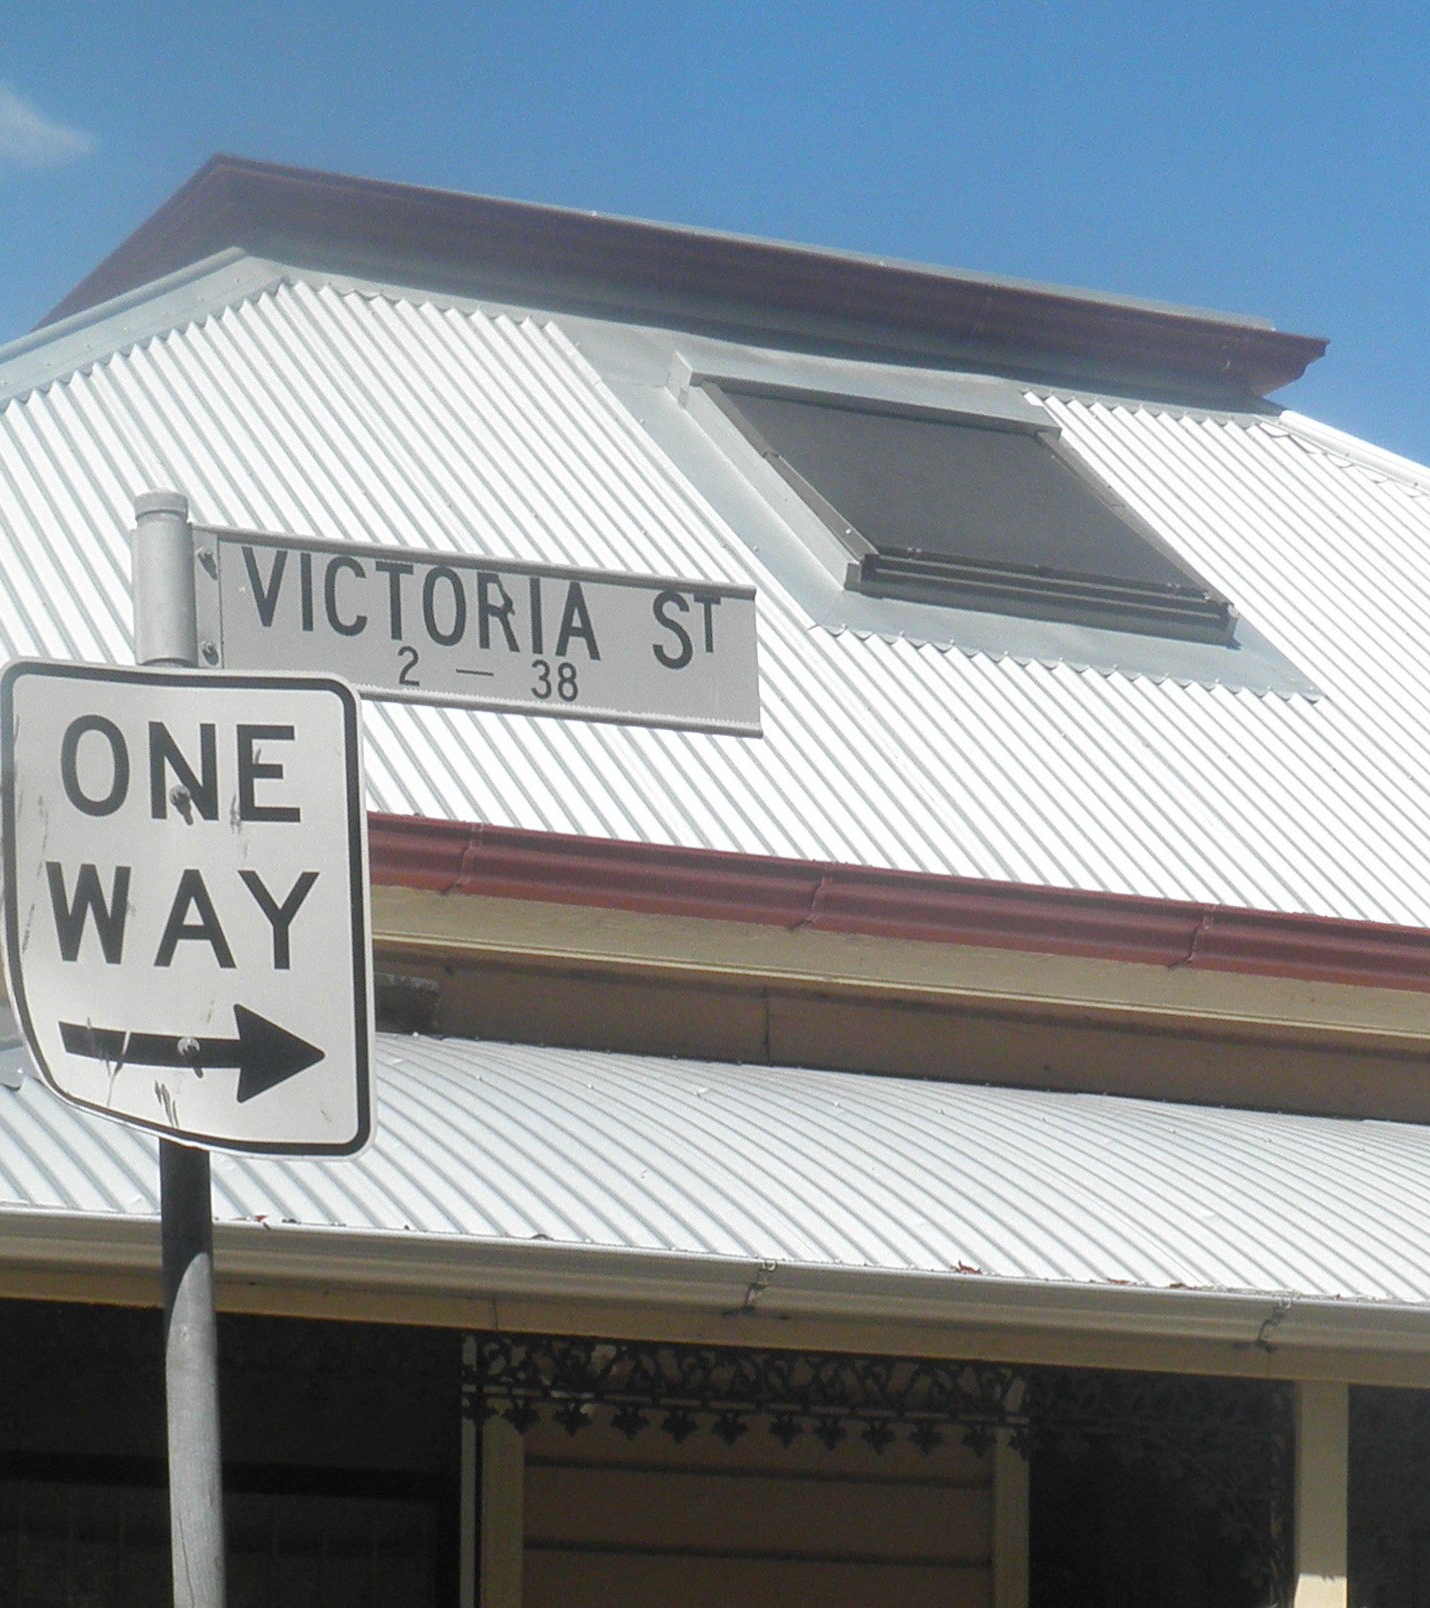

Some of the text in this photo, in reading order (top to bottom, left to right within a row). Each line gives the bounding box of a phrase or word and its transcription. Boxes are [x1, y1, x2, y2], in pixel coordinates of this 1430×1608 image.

[241, 545, 721, 670] VICTORIA ST
[397, 646, 420, 687] 2
[531, 660, 580, 701] 38
[60, 714, 301, 825] ONE
[46, 861, 320, 971] WAY
